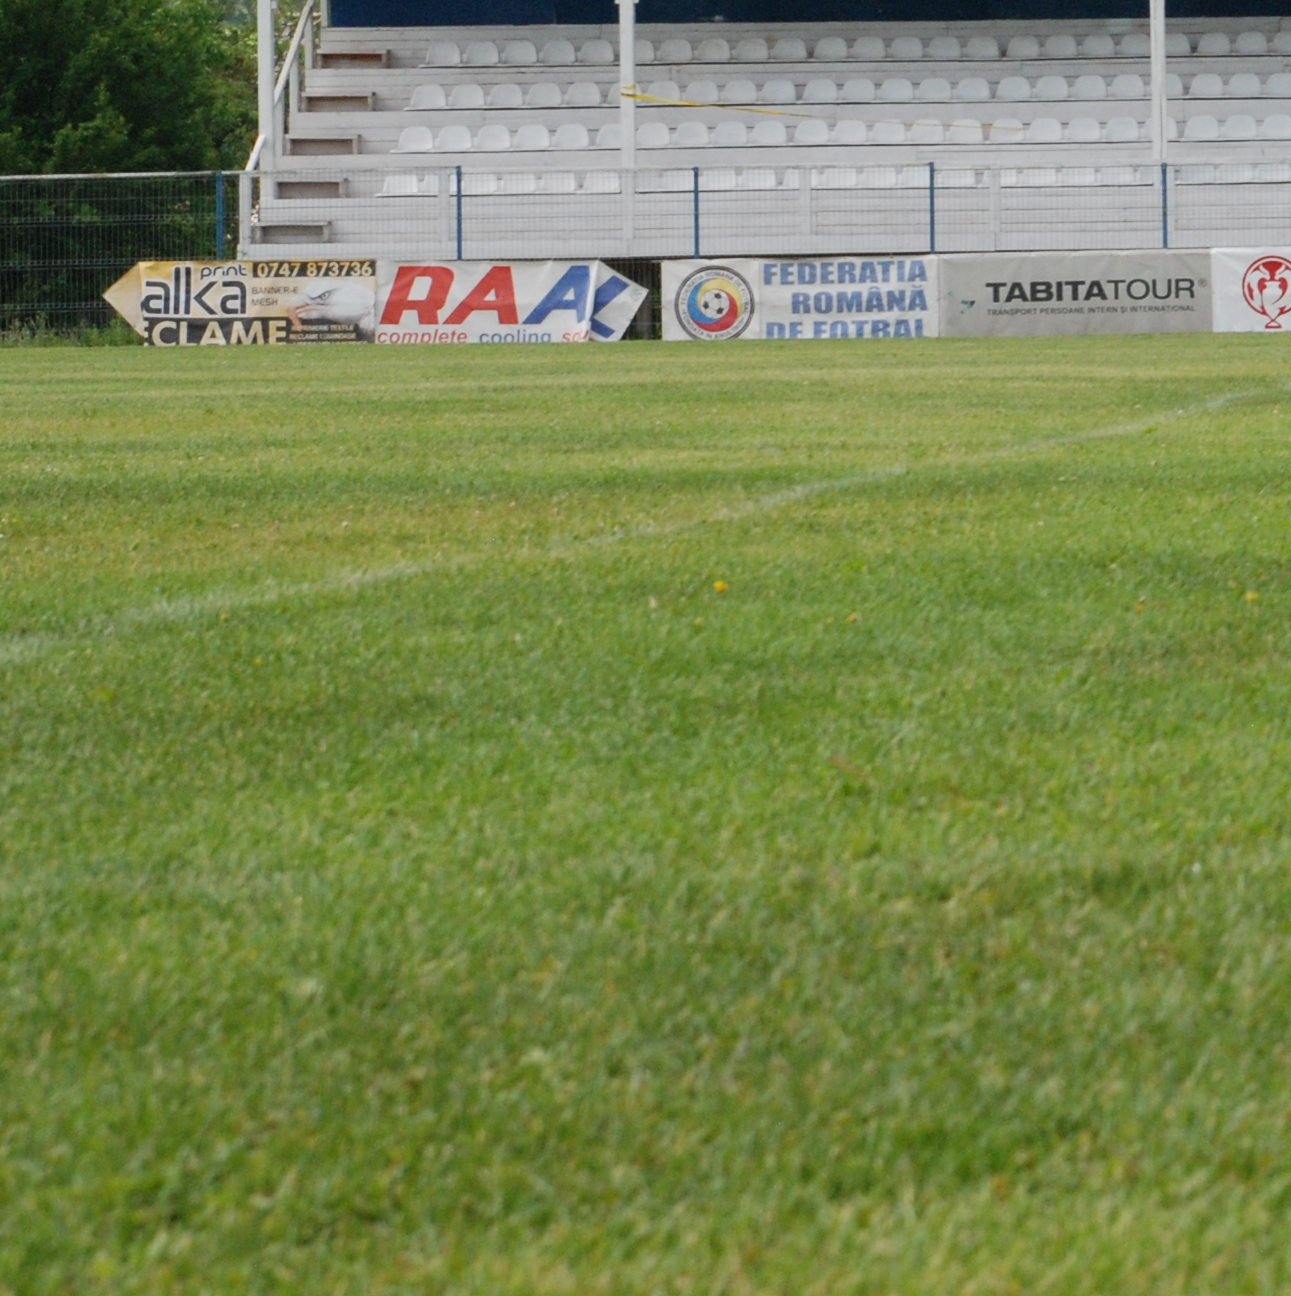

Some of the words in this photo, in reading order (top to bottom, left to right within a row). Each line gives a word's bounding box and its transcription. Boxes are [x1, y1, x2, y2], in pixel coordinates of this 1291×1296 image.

[200, 264, 248, 280] print
[256, 262, 301, 277] 0747
[307, 261, 372, 277] 873736
[763, 260, 928, 285] FEDERATIA
[141, 266, 247, 315] alka
[791, 284, 928, 314] ROMÂNĂ
[985, 278, 1196, 303] TABITATOUR
[251, 298, 278, 306] MESH
[986, 307, 1037, 315] TRANSPORT
[377, 328, 467, 343] complete
[479, 329, 551, 343] cooling
[766, 321, 804, 338] DE
[813, 319, 924, 338] FOTBAL
